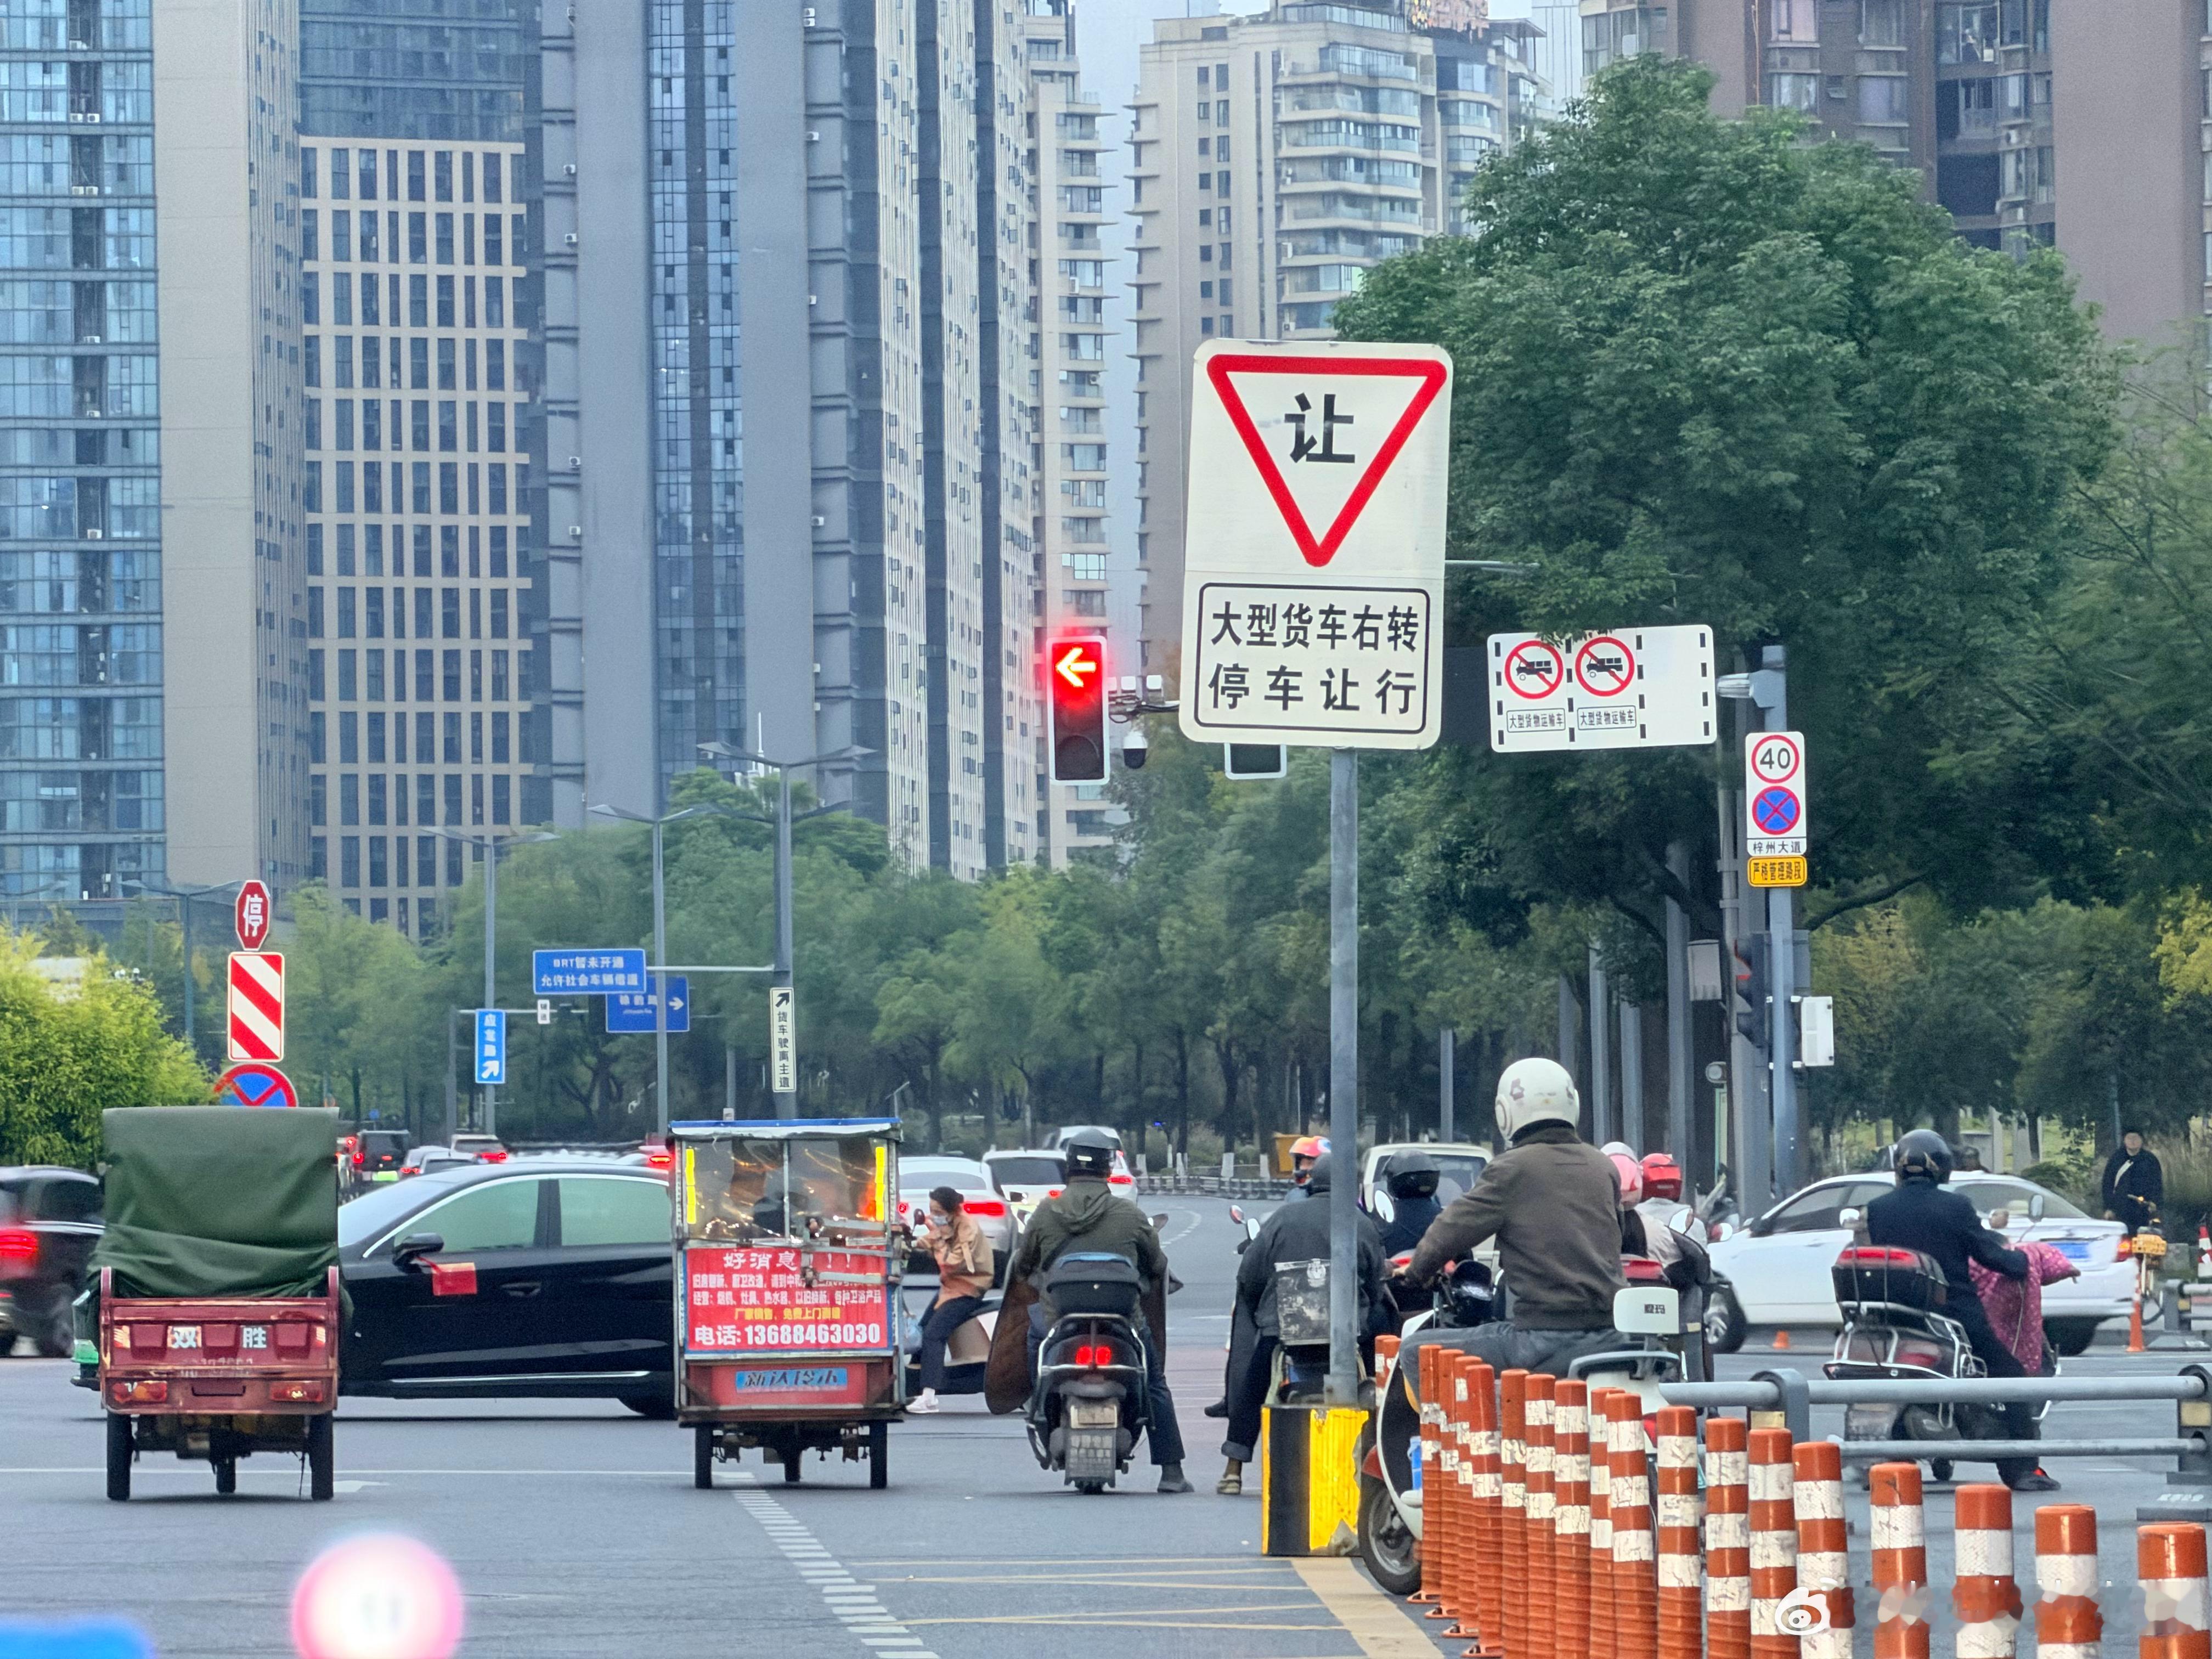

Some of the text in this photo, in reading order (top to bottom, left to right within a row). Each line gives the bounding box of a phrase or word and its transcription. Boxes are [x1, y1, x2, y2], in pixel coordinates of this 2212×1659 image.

[1285, 393, 1355, 463] 让
[1211, 601, 1419, 652] 大型货车右转
[1208, 663, 1417, 714] 停车让行
[1509, 713, 1564, 729] 大型货物运输车
[1580, 710, 1635, 725] 大型货物运输车
[1760, 748, 1791, 769] 40
[1753, 841, 1801, 854] 梓州大道
[242, 894, 263, 937] 停
